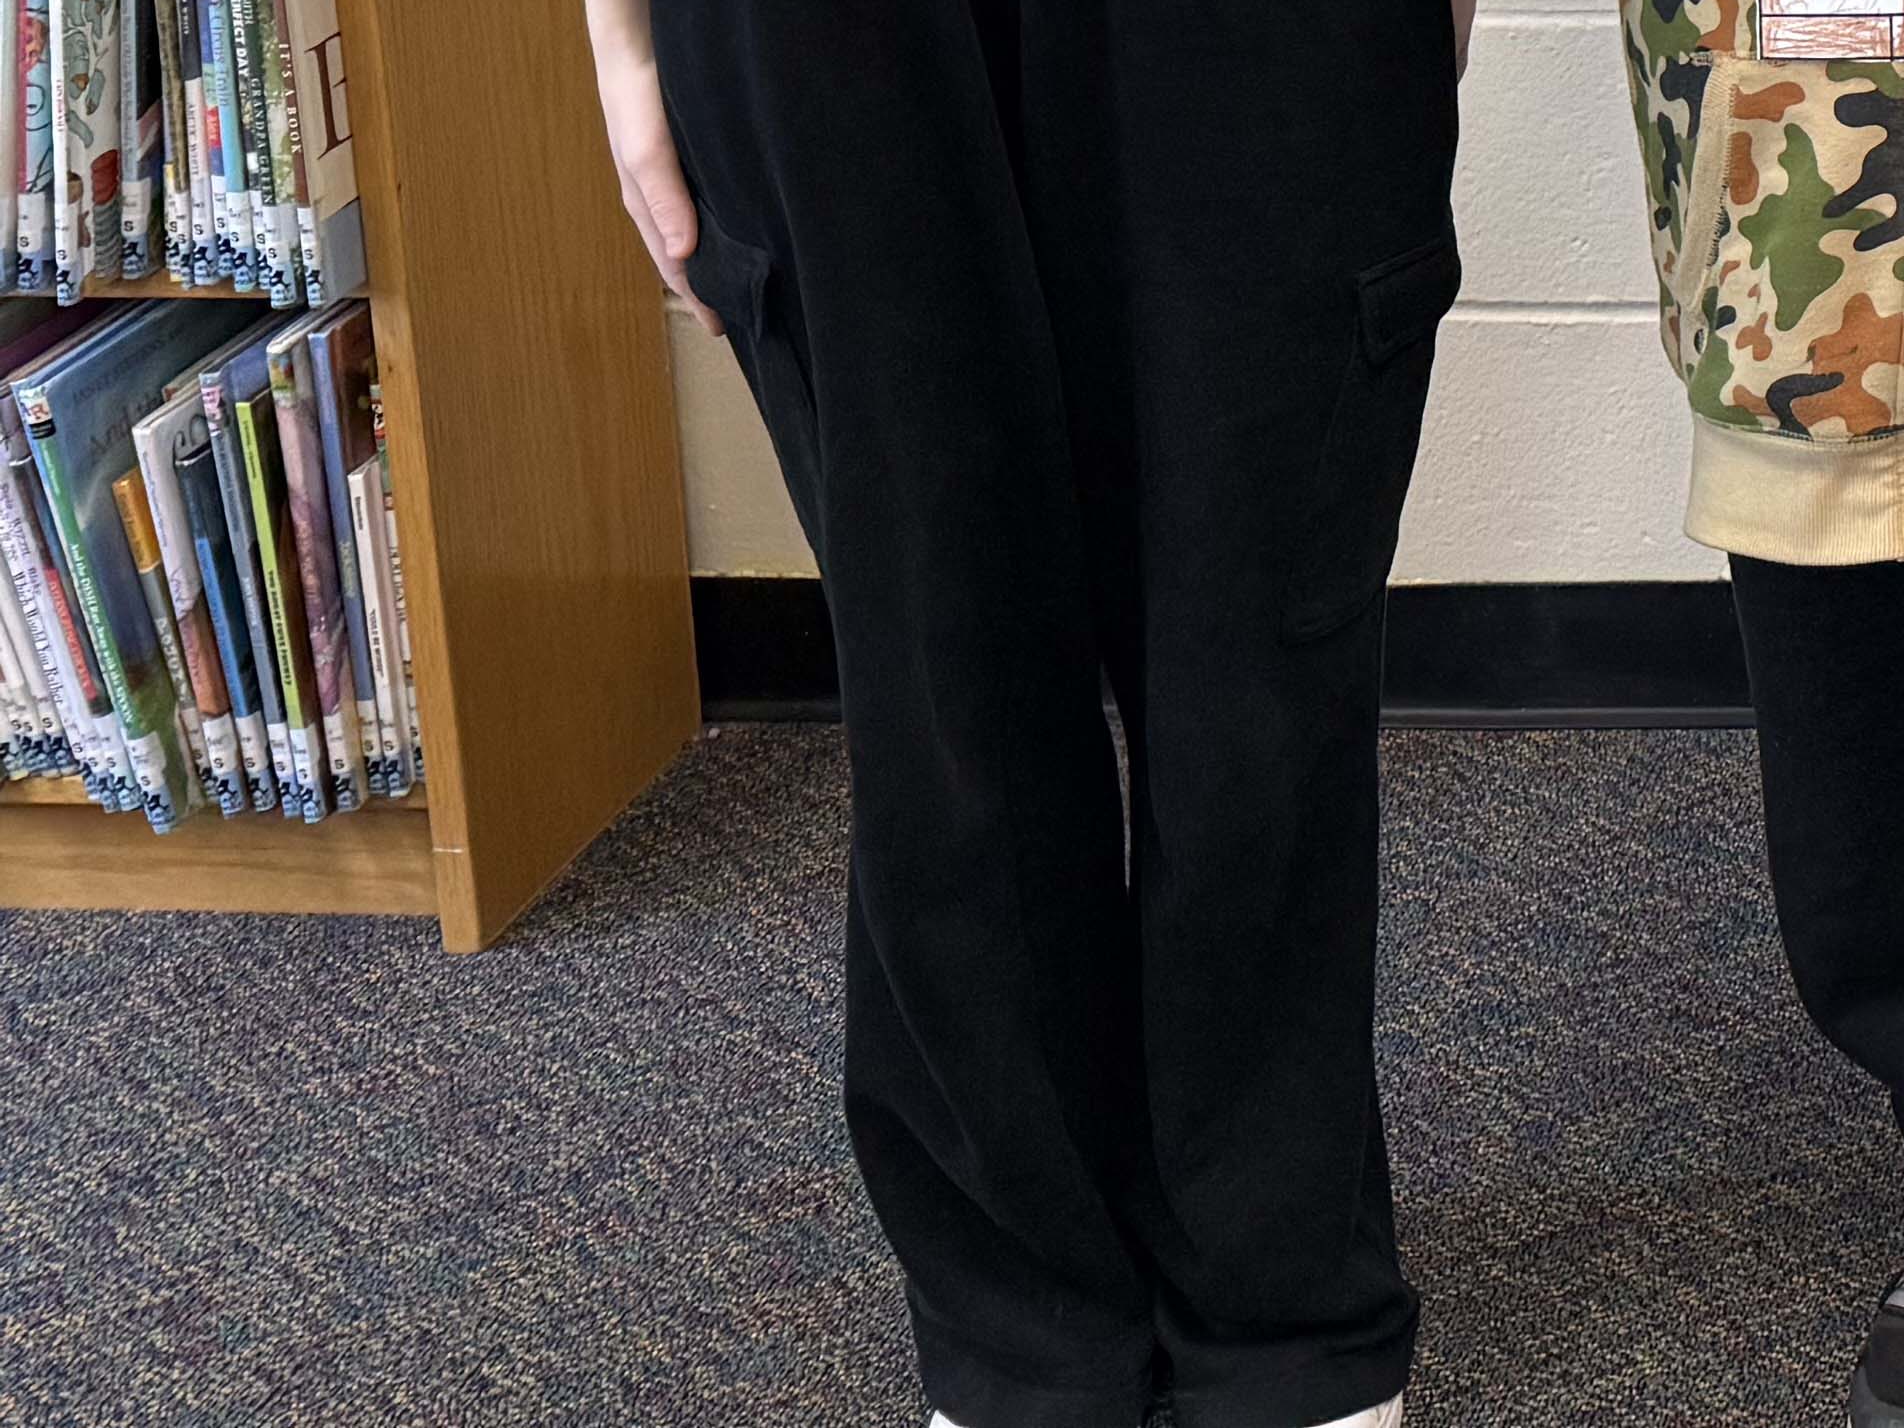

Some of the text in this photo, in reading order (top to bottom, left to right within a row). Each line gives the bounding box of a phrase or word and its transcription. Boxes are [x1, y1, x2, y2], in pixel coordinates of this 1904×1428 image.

[235, 46, 249, 78] DAY
[248, 77, 268, 149] GRANDPA
[285, 106, 302, 153] BOOK
